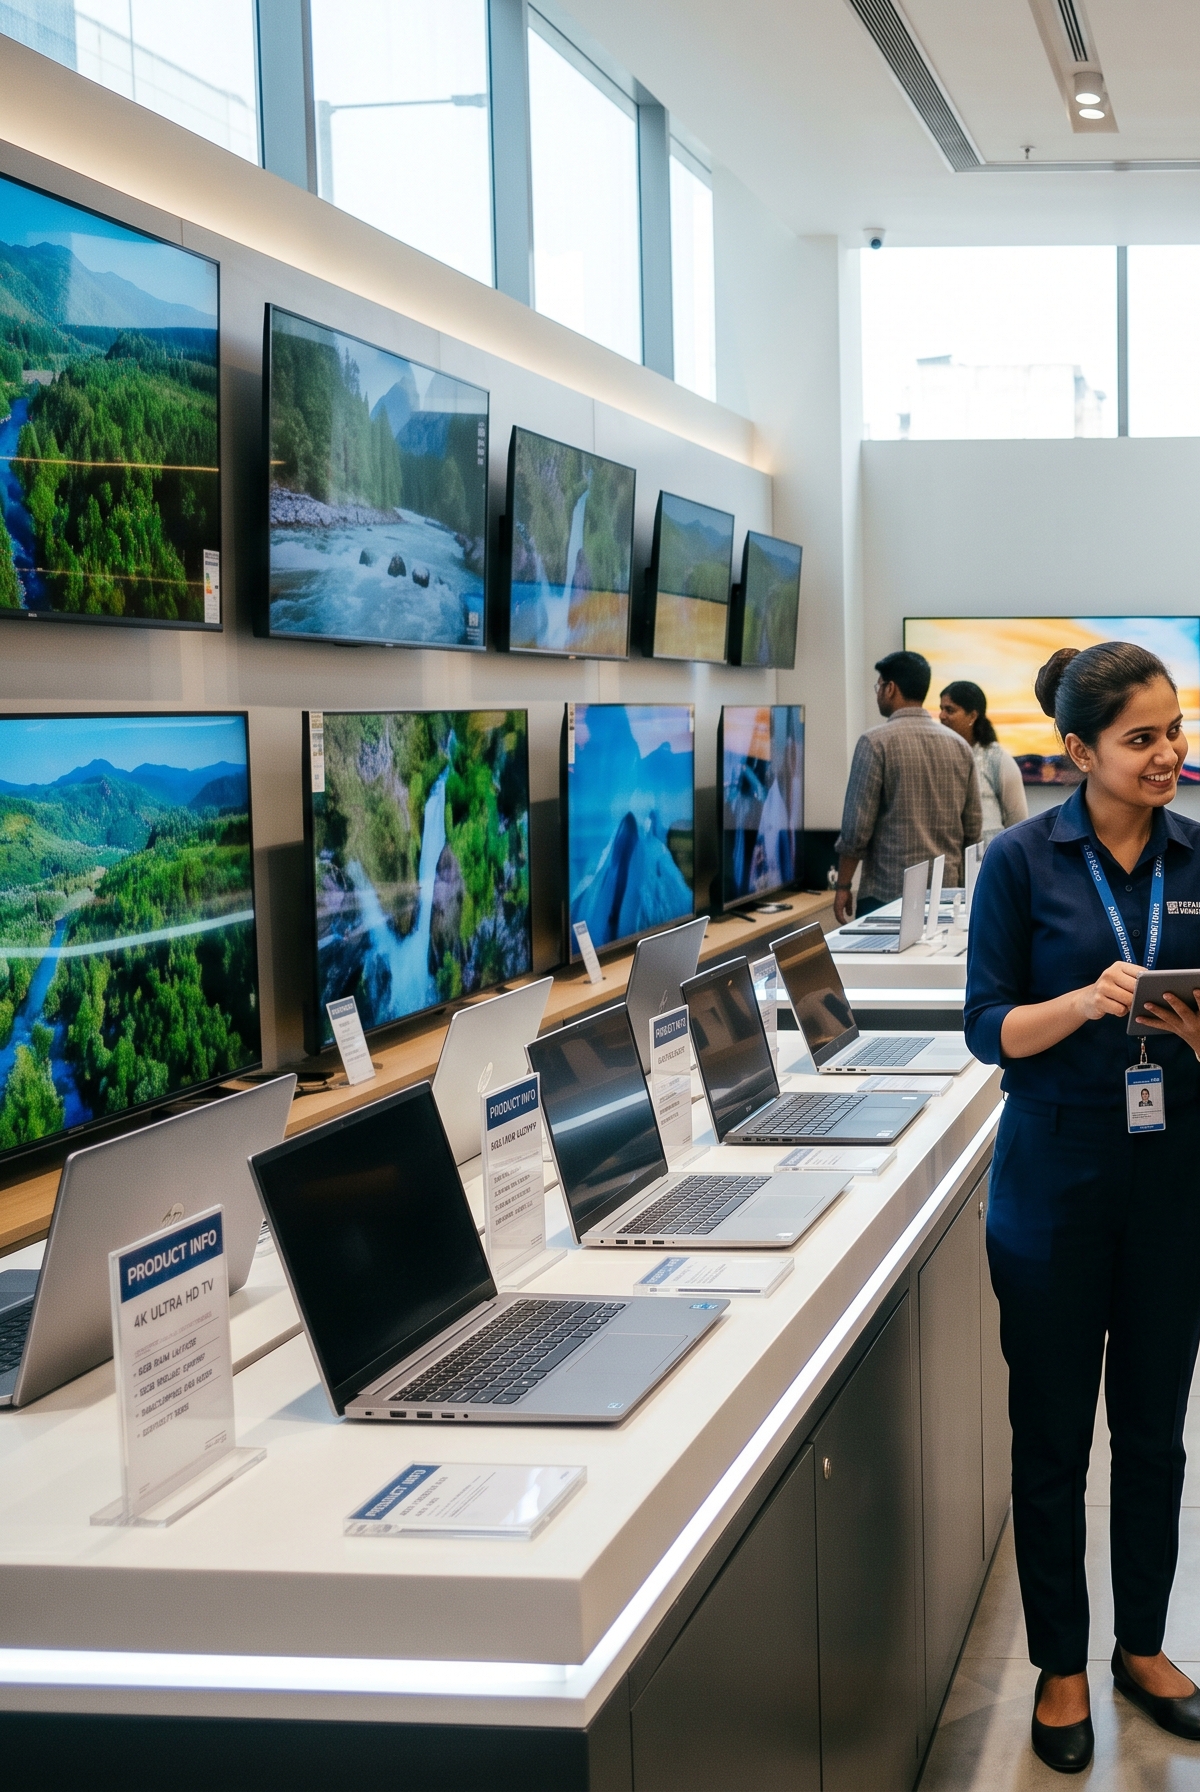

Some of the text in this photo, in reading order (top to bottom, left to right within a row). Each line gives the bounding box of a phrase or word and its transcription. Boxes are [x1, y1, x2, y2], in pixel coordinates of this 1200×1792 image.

[127, 1229, 217, 1286] PRODUCT INFO
[134, 1278, 214, 1328] 4K ULTRA HD TV
